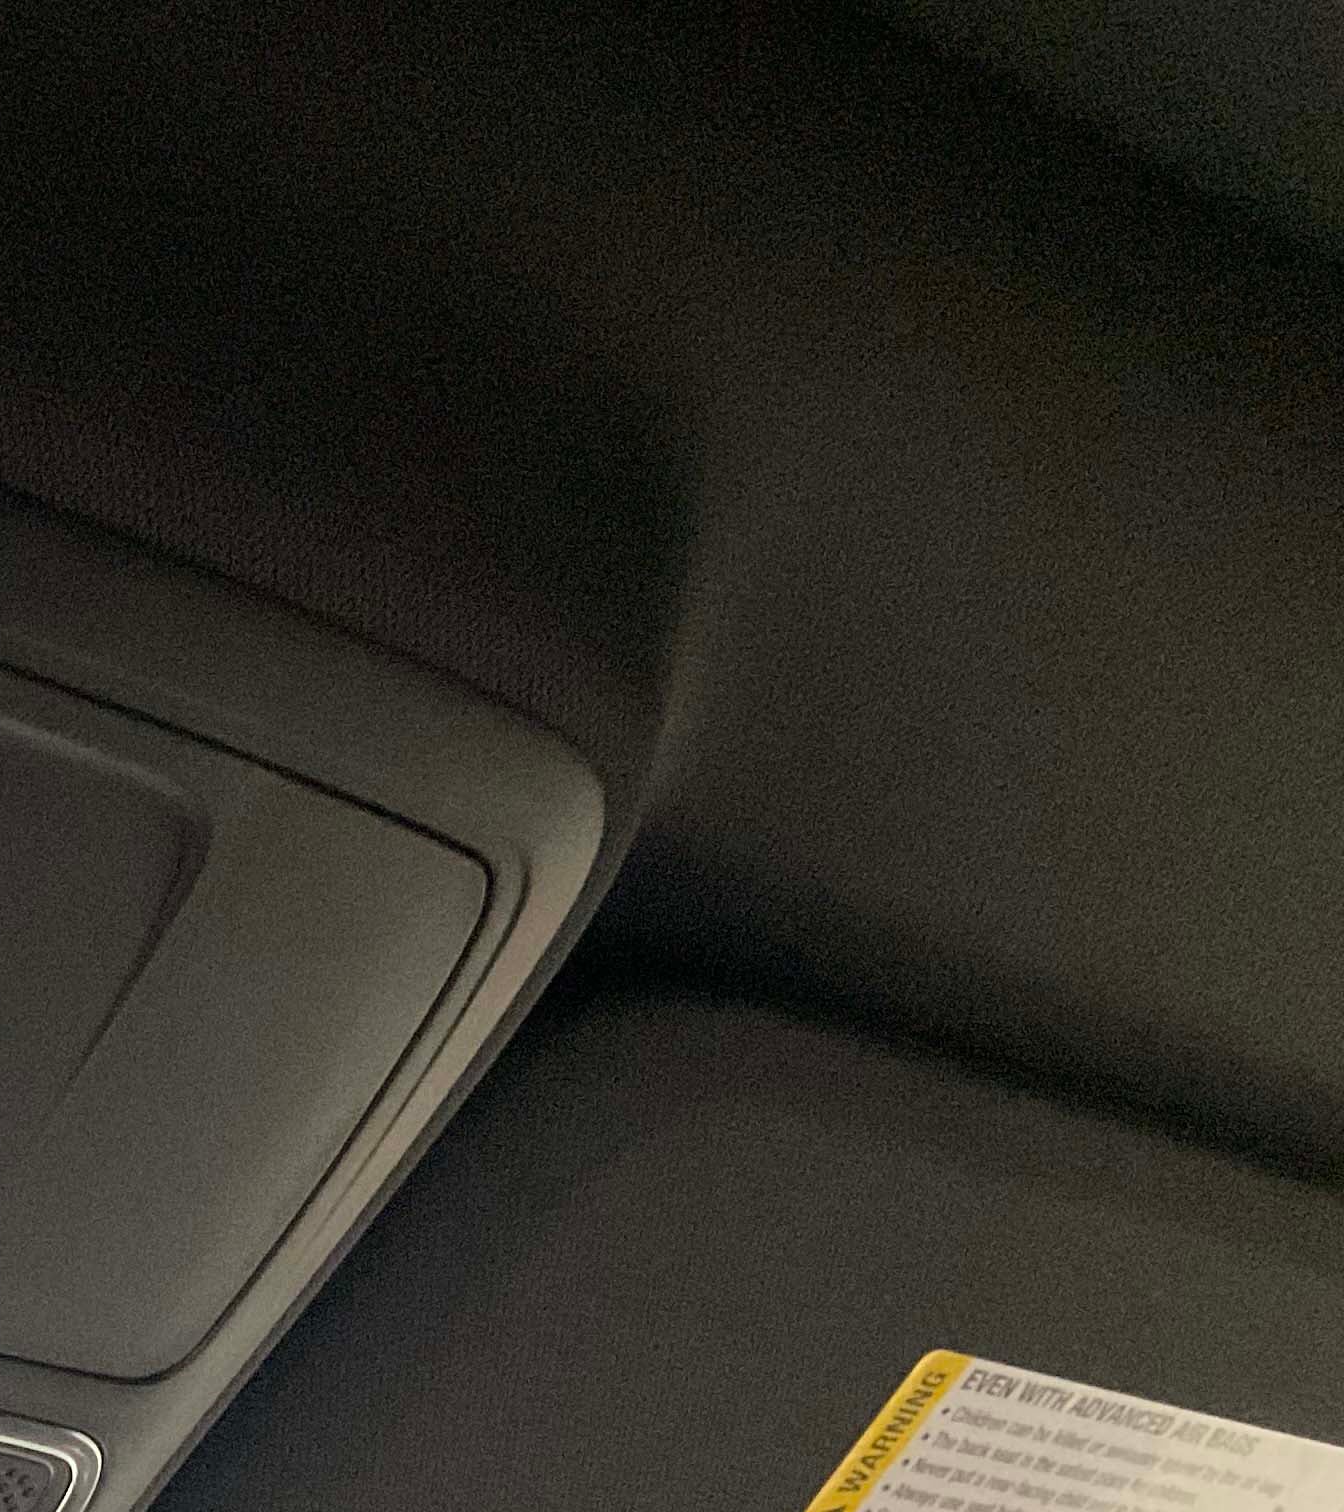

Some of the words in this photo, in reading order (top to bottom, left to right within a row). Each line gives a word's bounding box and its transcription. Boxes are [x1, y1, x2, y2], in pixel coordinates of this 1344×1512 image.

[839, 1369, 948, 1494] WARNING
[961, 1369, 1020, 1399] EVEN
[1018, 1381, 1075, 1412] WITH
[1067, 1395, 1175, 1435] ADVANCED
[1169, 1421, 1211, 1445] AIR
